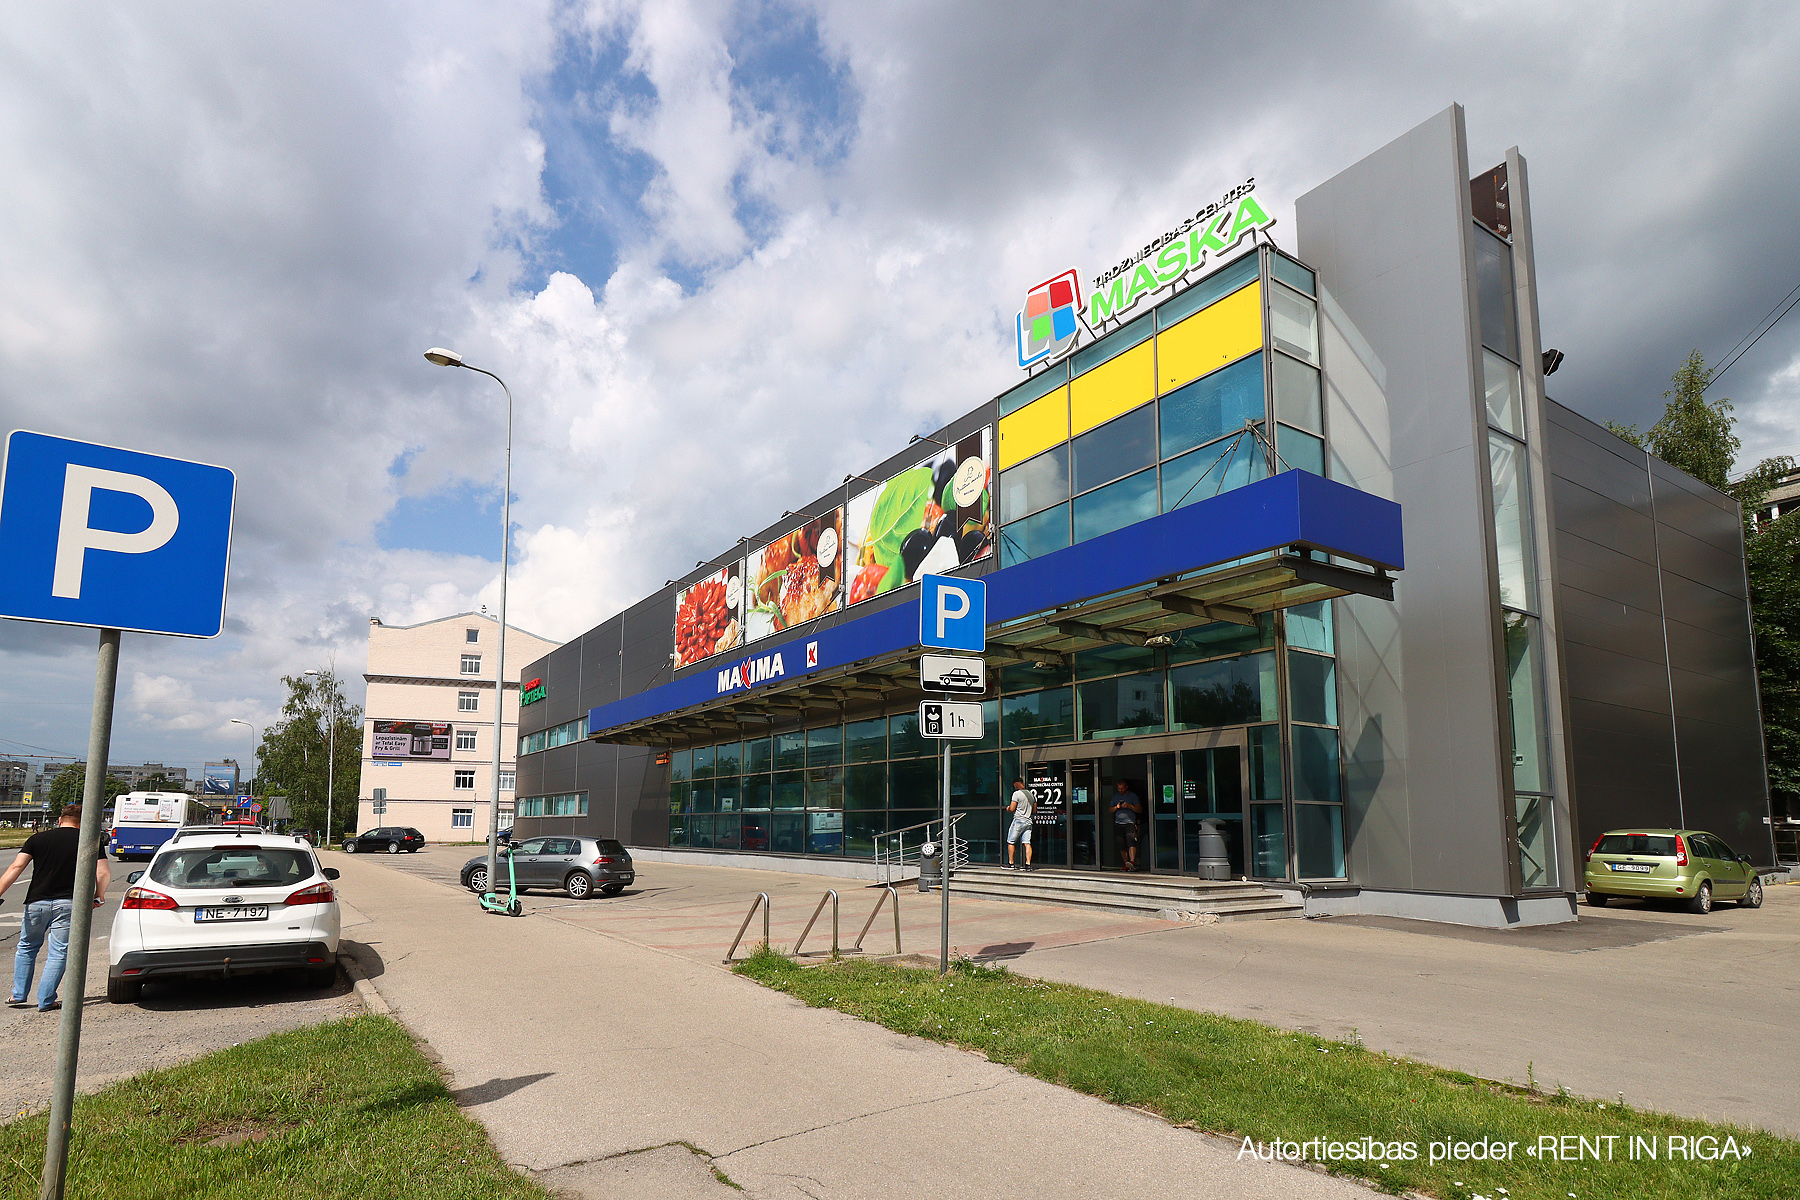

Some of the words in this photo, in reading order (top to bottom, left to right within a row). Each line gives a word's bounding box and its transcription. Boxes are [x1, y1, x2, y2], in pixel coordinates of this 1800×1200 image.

[1091, 195, 1270, 326] MASKA
[52, 463, 180, 600] P
[936, 584, 971, 639] P
[717, 652, 785, 693] MAXIMA
